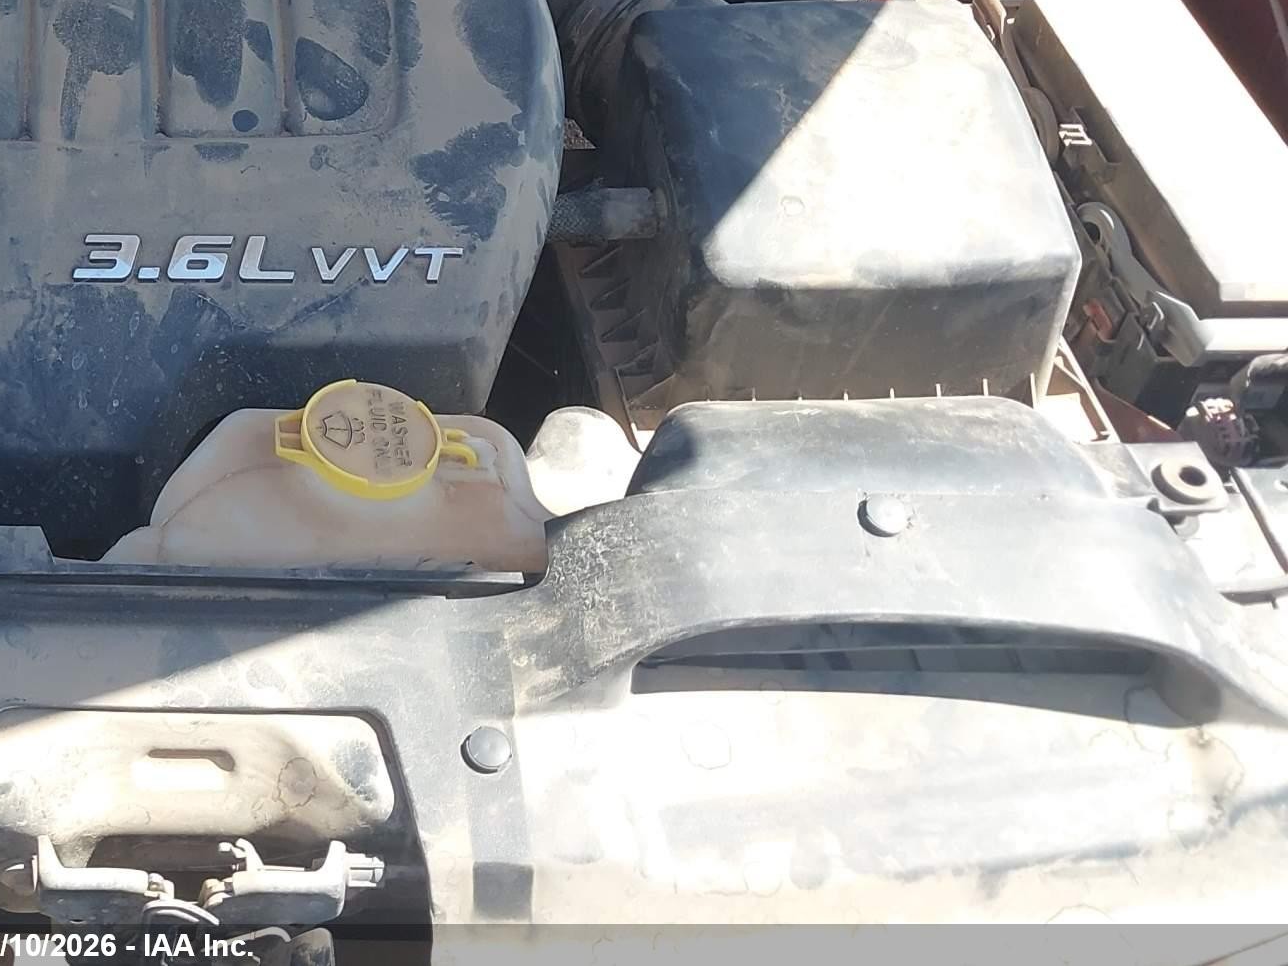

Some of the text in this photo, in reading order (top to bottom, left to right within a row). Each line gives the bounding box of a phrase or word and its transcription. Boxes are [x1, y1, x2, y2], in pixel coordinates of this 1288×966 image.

[72, 234, 464, 283] 3.6L VVT
[368, 389, 388, 432] FLUID
[389, 401, 413, 468] WASHER
